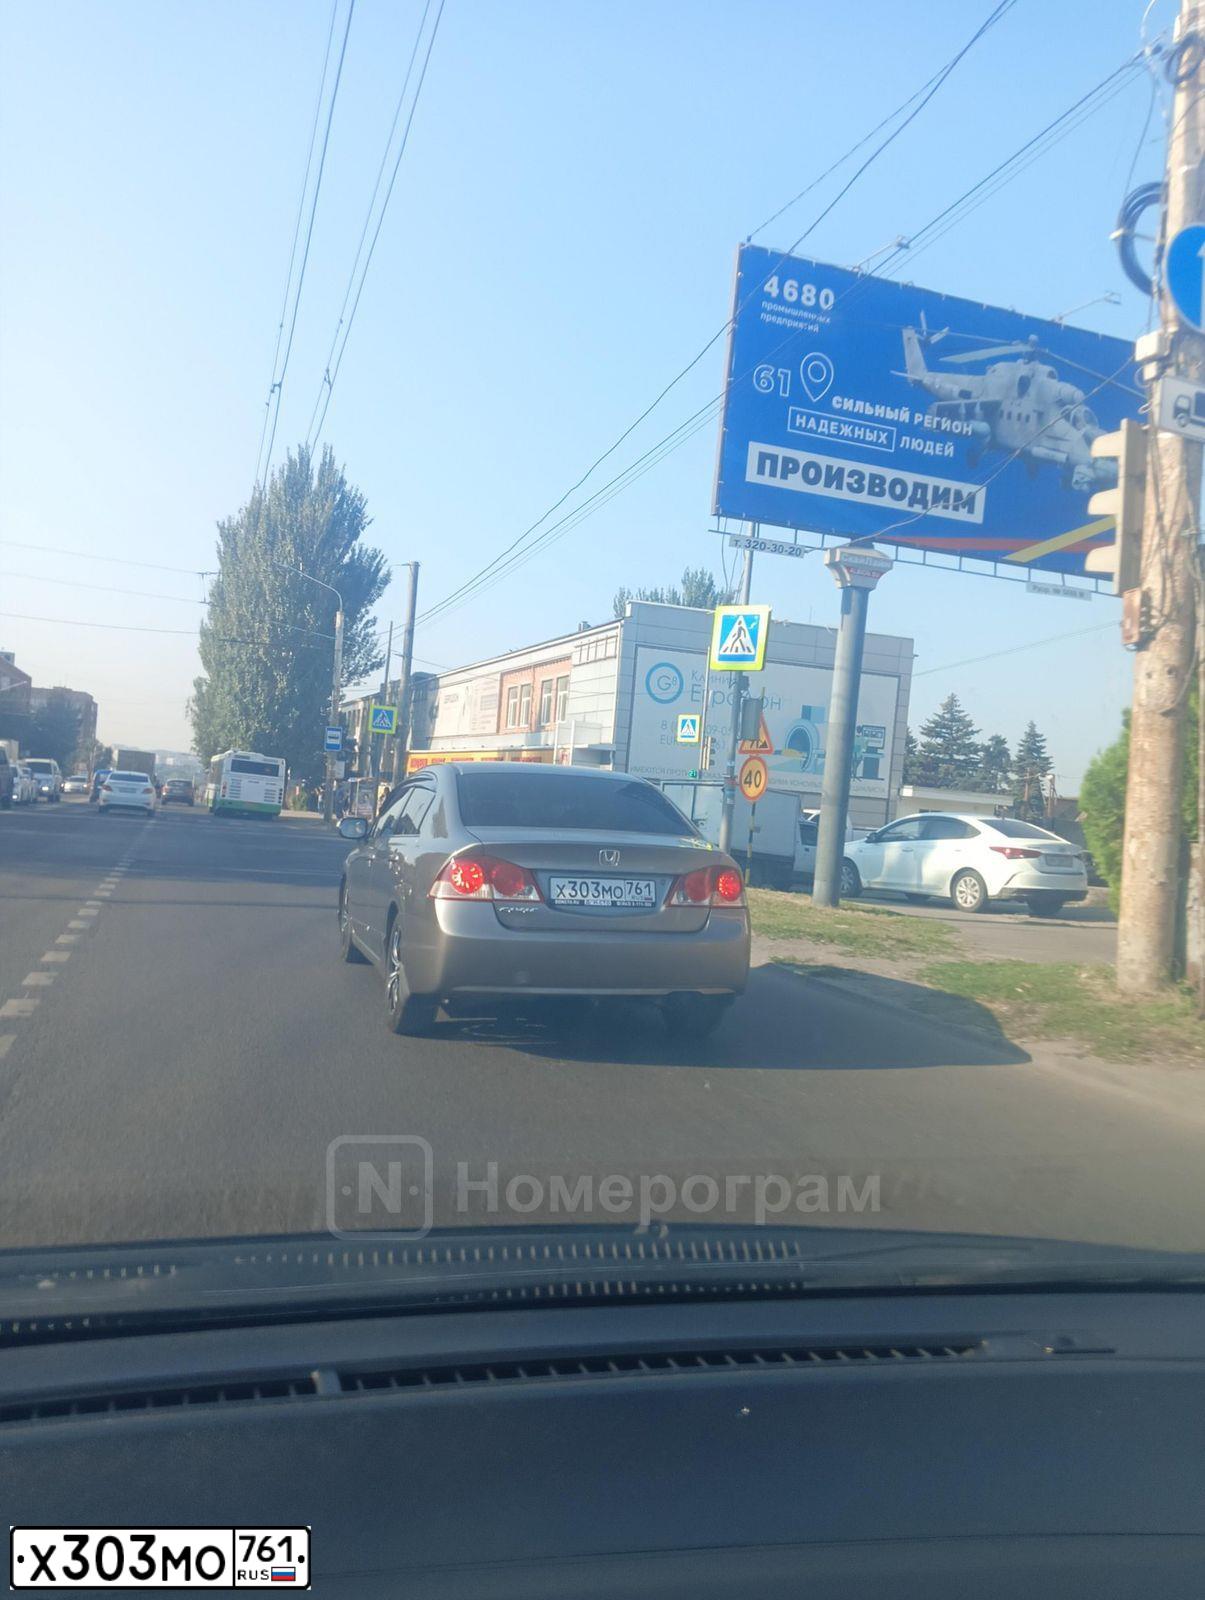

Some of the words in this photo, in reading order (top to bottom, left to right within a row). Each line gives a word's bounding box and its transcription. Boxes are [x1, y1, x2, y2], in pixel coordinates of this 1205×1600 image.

[763, 275, 835, 310] 4680
[760, 312, 819, 333] предприятий
[753, 364, 791, 397] 61
[831, 395, 910, 423] СИЛЬНЫЙ
[913, 412, 974, 436] РЕГИОН
[795, 413, 888, 445] НАДЕЖНЫХ
[899, 435, 955, 458] ЛЮДЕЙ
[756, 451, 977, 515] ПРОИЗВОДИМ
[744, 539, 801, 558] 320-30-20
[743, 769, 762, 789] 40
[556, 881, 624, 900] Х303МО
[626, 881, 652, 896] 761
